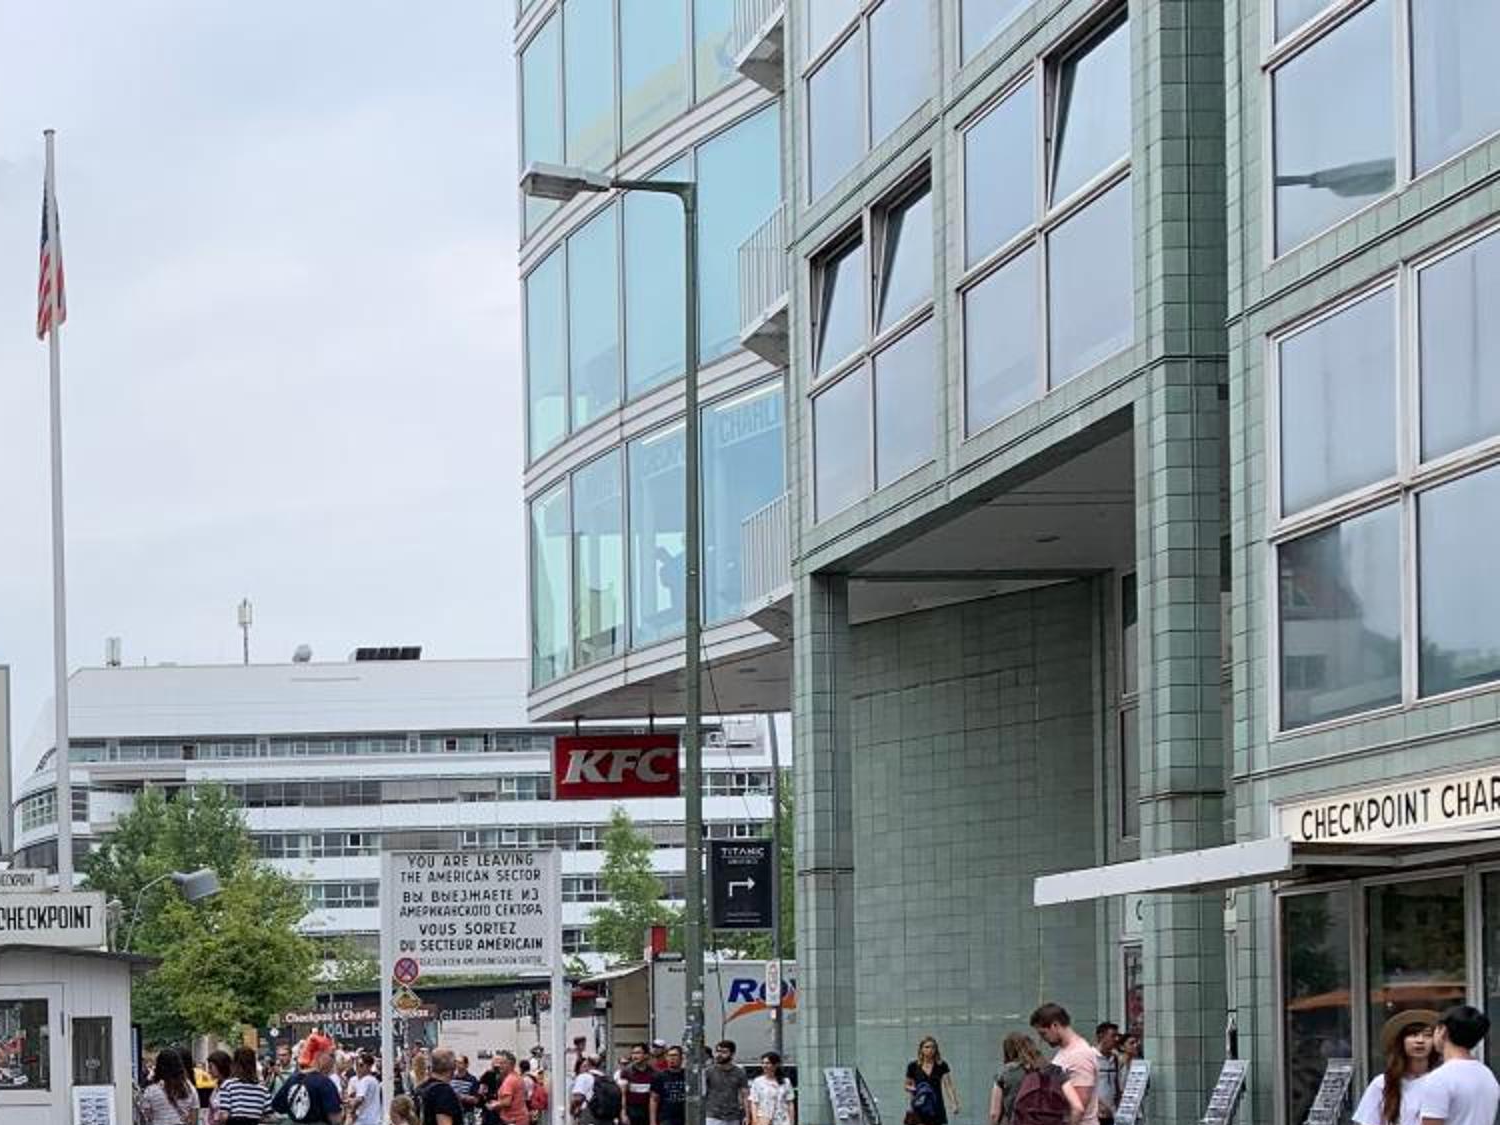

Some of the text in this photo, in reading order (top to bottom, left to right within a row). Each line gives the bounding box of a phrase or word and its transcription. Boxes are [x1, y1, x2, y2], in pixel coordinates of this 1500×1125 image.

[561, 748, 677, 784] KFC
[1301, 788, 1431, 841] CHECKPOINT
[720, 847, 765, 857] TITANIC
[407, 853, 533, 868] YOU ARE LEAVING
[401, 869, 541, 882] THE AMERICAN SECTOR
[522, 888, 539, 901] ИЗ
[419, 922, 517, 936] VOUS SORTEZ
[420, 939, 473, 951] SECTEUR
